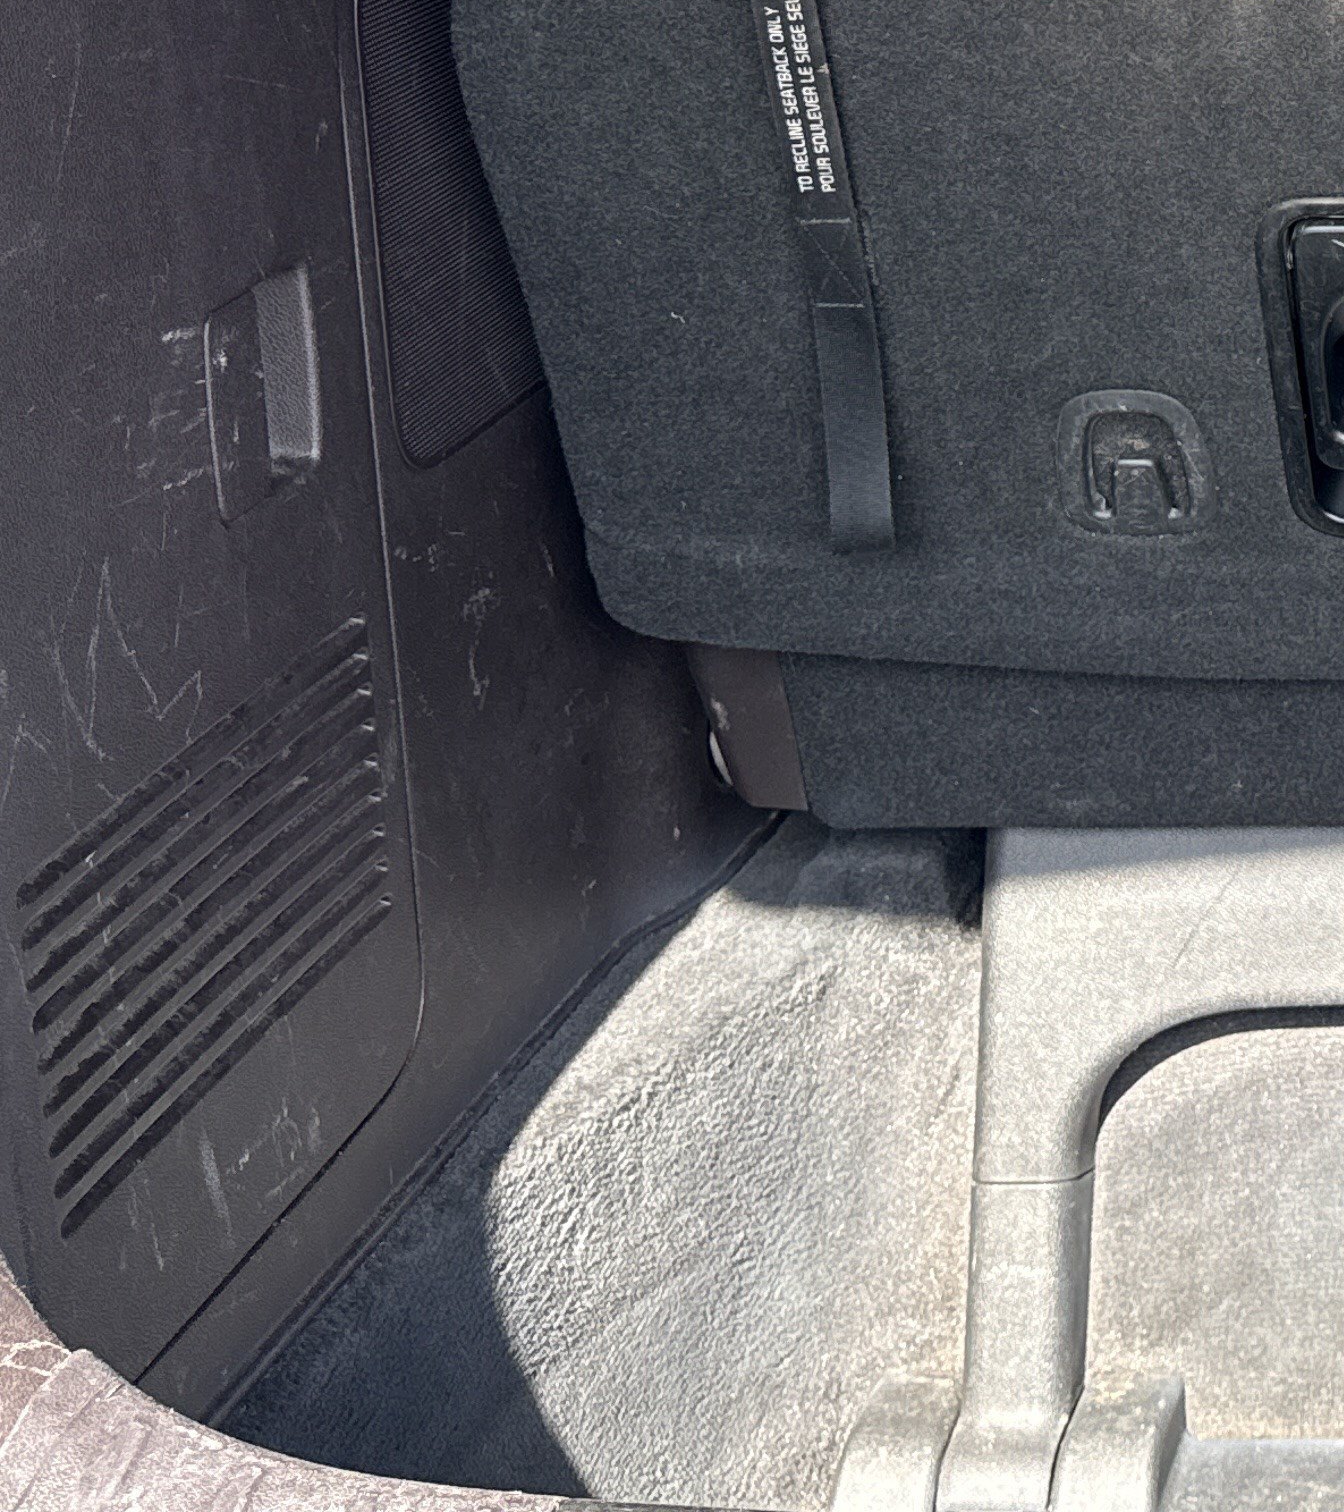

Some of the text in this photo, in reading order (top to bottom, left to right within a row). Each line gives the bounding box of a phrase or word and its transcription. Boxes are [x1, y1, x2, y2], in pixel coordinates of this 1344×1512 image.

[764, 6, 815, 194] TO RECLINE SEATBACK ONLY
[798, 66, 815, 84] LE
[802, 85, 830, 154] SOULEVER
[816, 157, 837, 193] POUR
